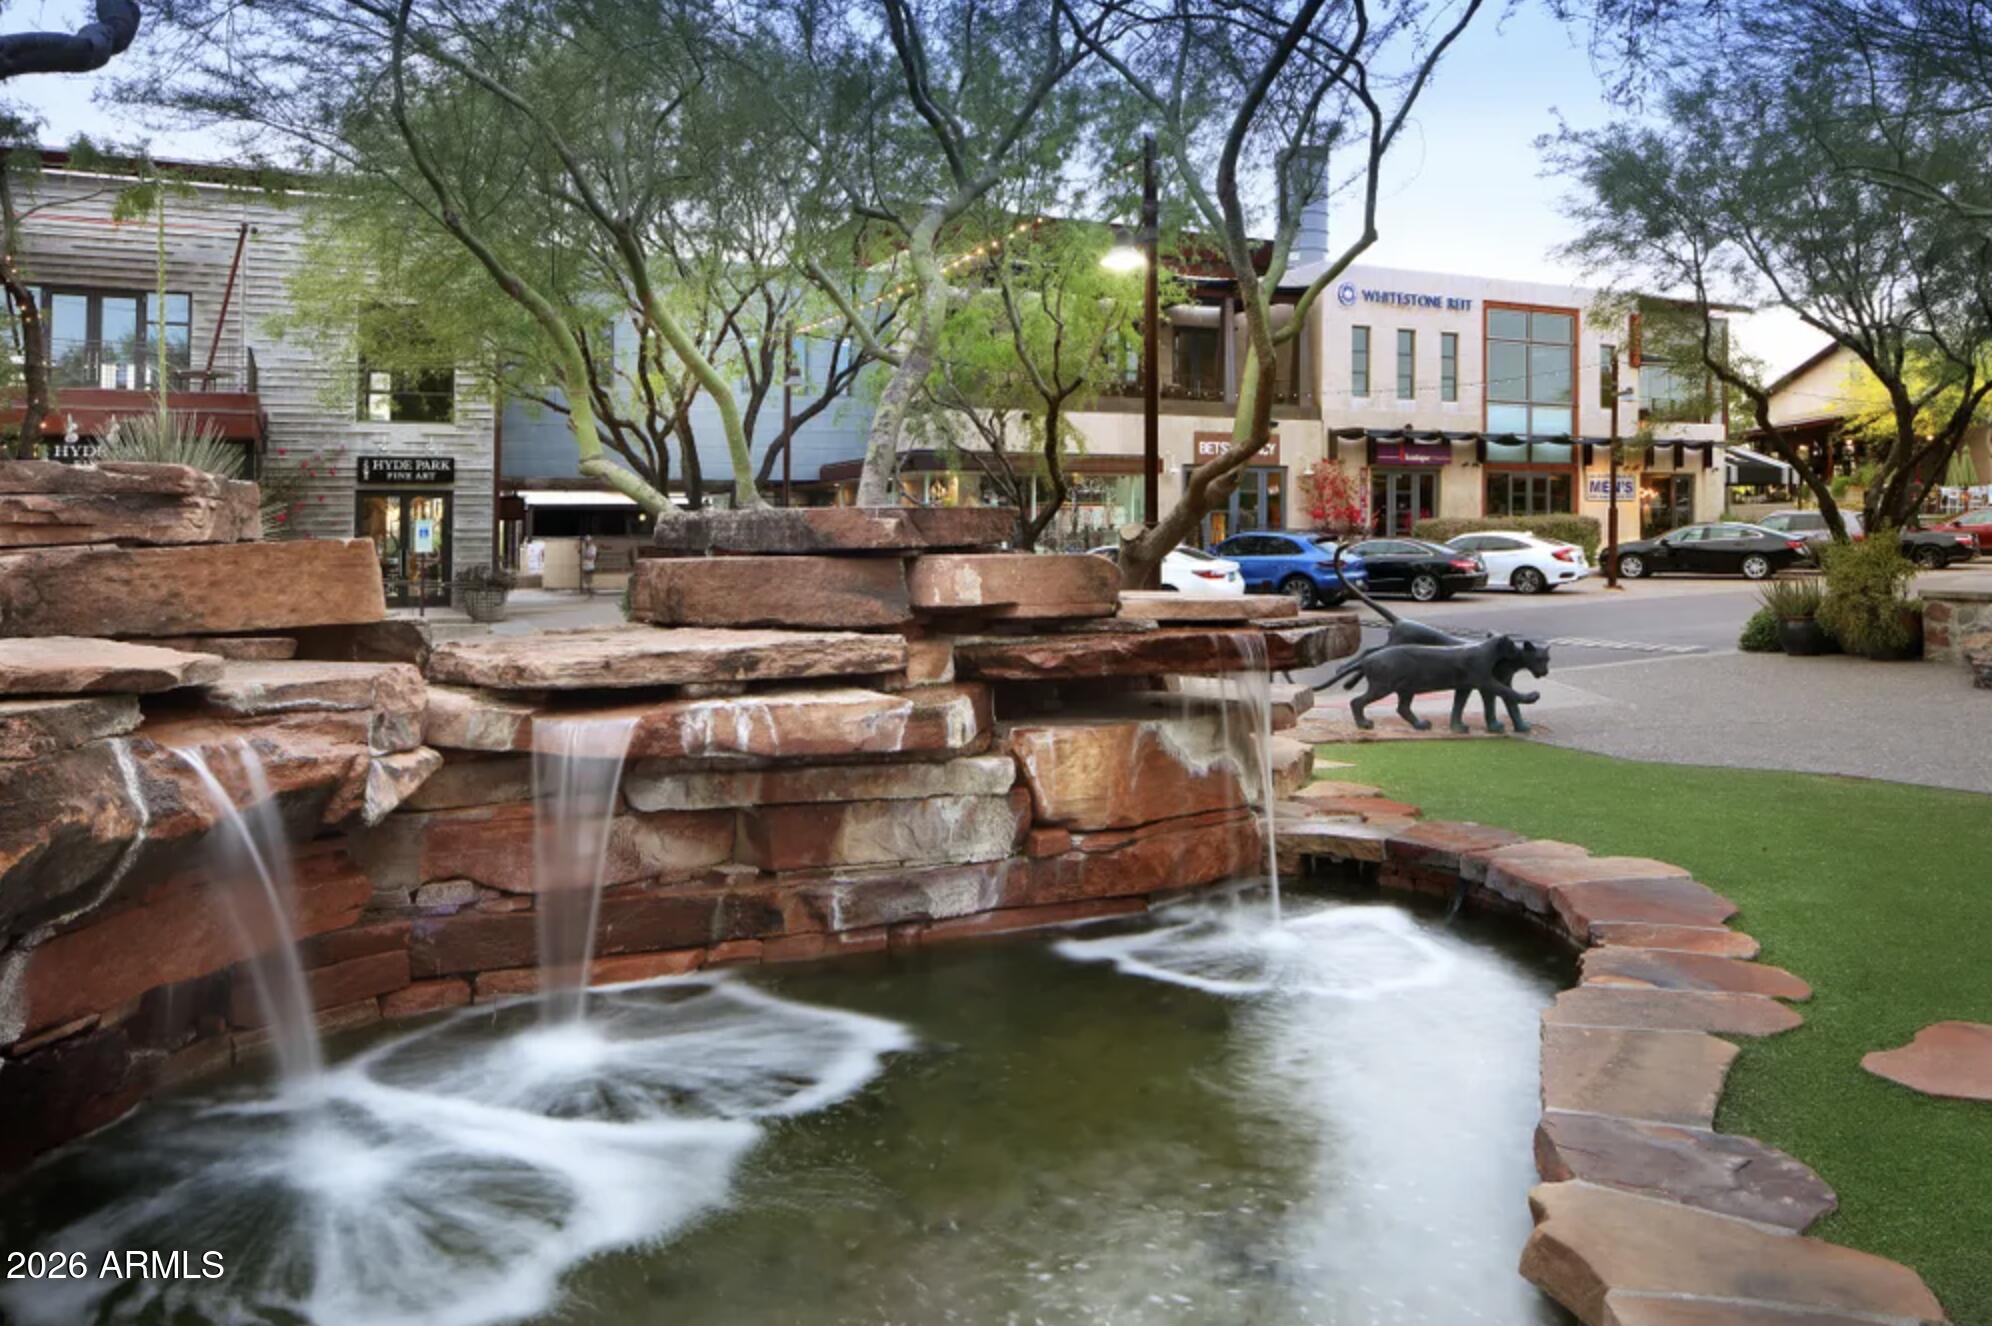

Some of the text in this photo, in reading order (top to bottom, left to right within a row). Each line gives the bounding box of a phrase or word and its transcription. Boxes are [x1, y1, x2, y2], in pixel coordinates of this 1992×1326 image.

[1361, 289, 1472, 311] WHITESTONE REIT
[1199, 441, 1234, 455] BETS
[372, 459, 451, 471] HYDE PARK
[415, 471, 437, 480] ART
